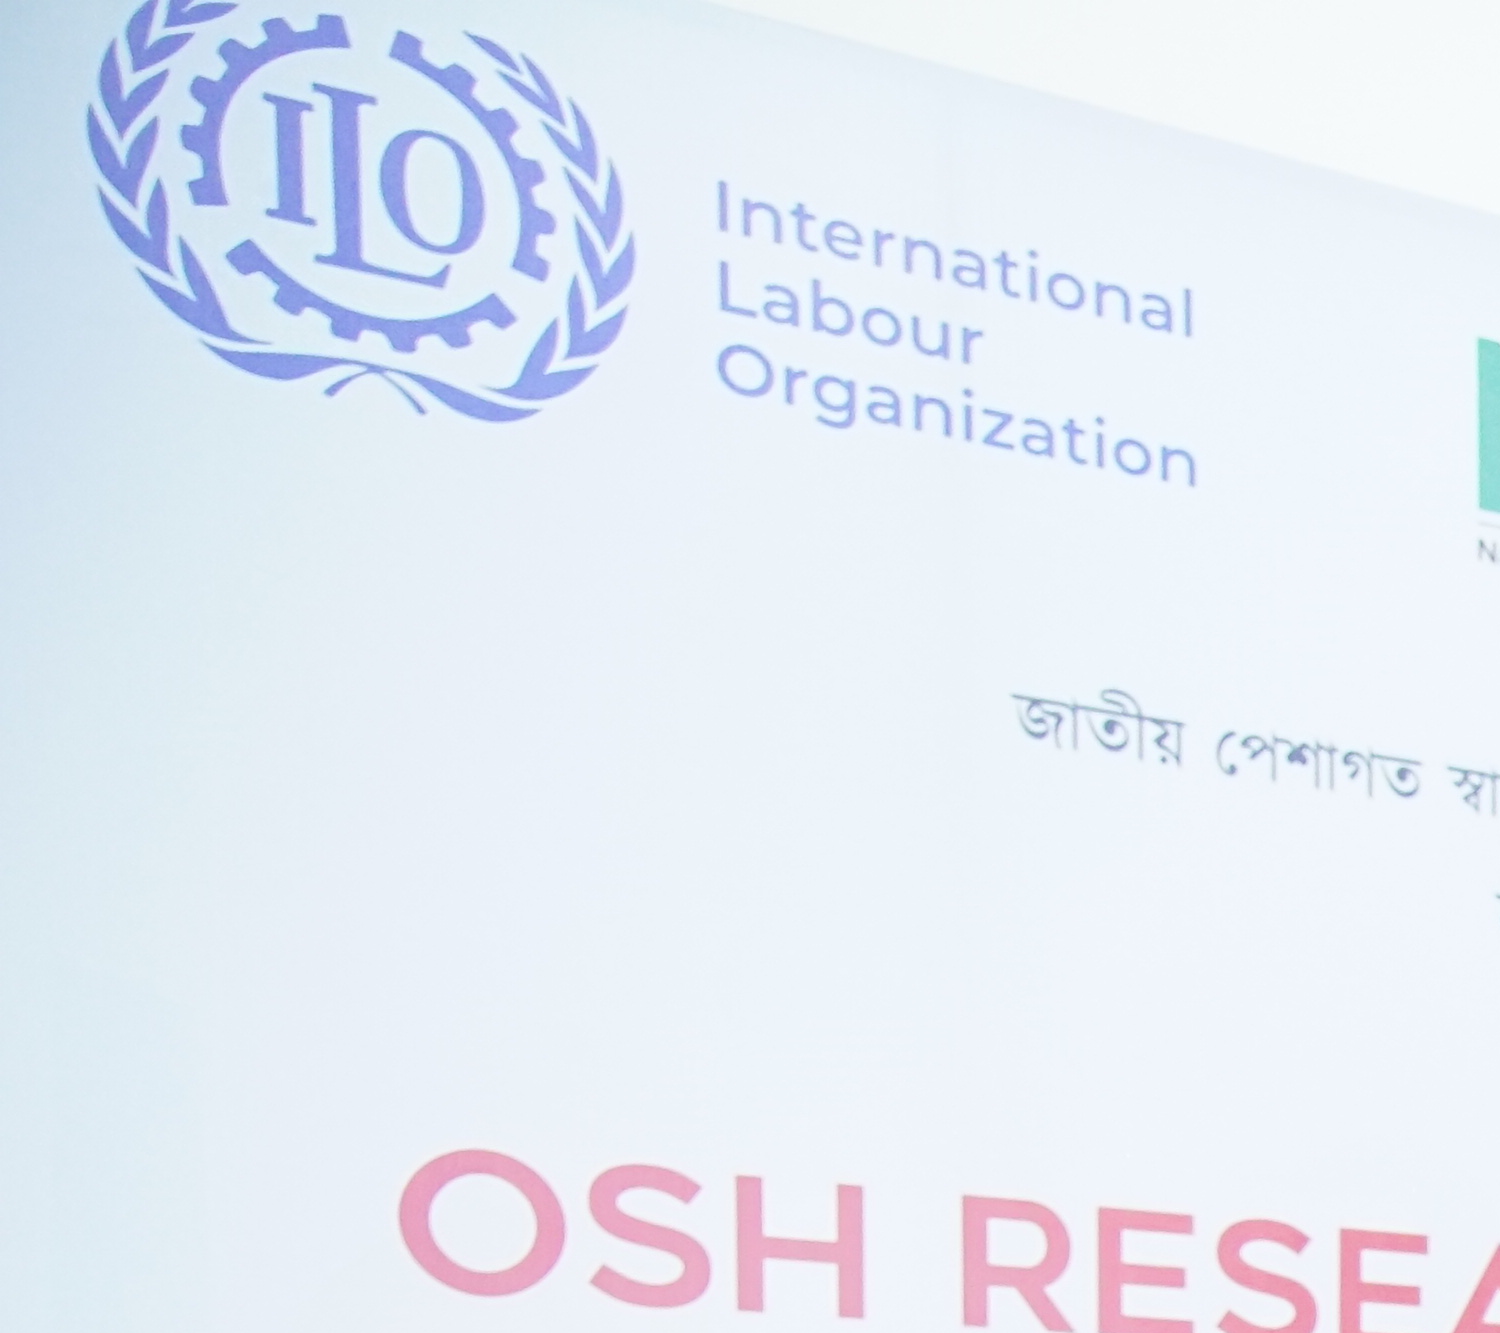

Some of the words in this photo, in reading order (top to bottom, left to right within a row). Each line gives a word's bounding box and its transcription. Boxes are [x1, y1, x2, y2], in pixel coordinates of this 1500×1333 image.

[260, 82, 486, 289] ILO
[715, 179, 1195, 339] International
[715, 260, 986, 366] Labour
[715, 342, 1200, 488] Organization
[1011, 689, 1186, 770] জাতীয়
[1215, 729, 1422, 799] পেশাগত
[396, 1147, 866, 1320] OSH
